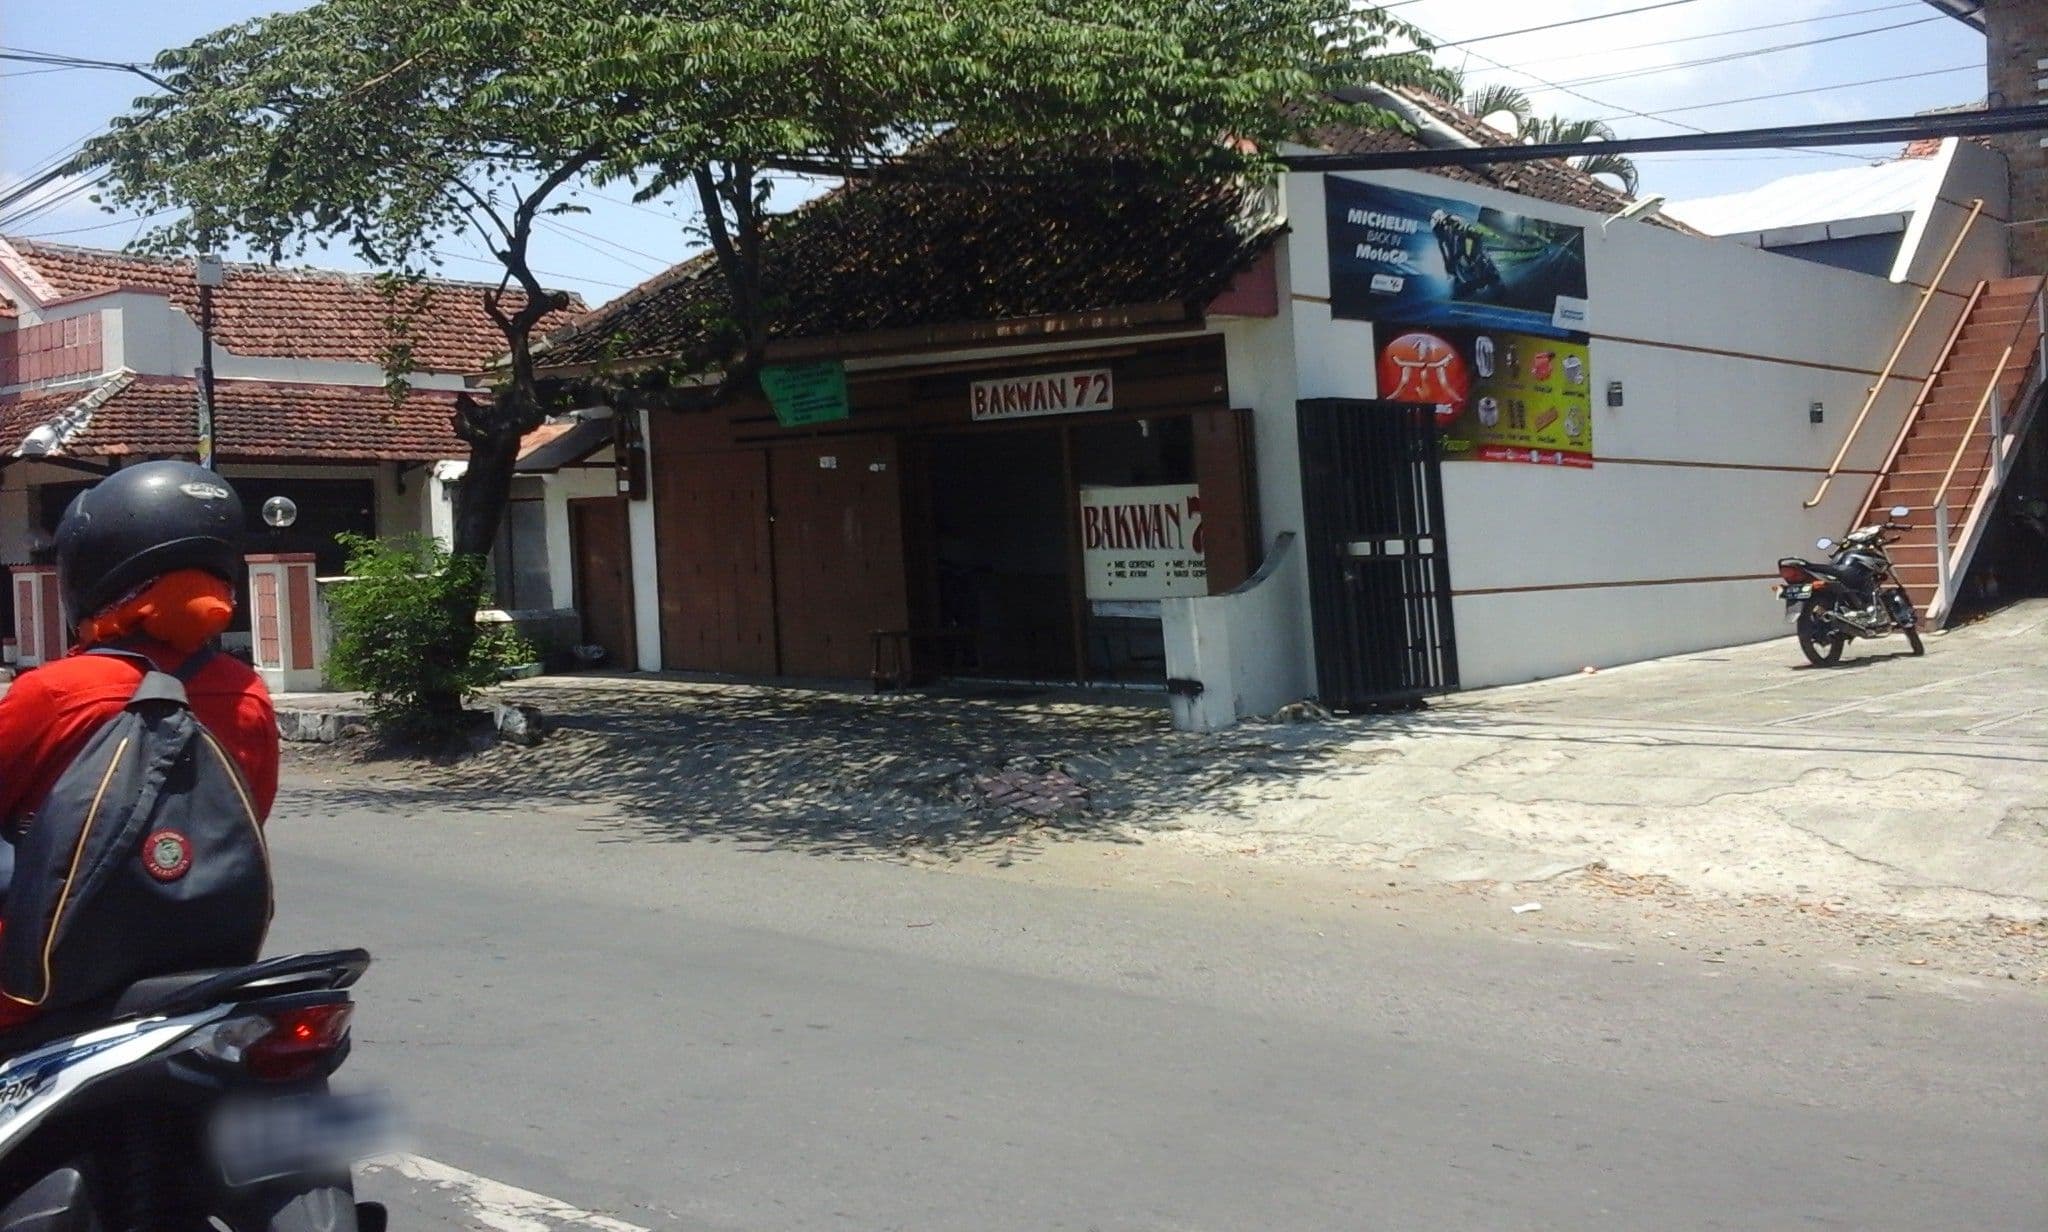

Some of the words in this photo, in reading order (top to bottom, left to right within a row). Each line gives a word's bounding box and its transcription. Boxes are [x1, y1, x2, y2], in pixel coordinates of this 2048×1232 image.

[1347, 207, 1418, 234] MICHELIN
[1355, 243, 1409, 264] MotoGP
[974, 378, 1067, 415] BAKWAN
[1073, 373, 1110, 407] 72
[1083, 503, 1185, 551] BAKWAN
